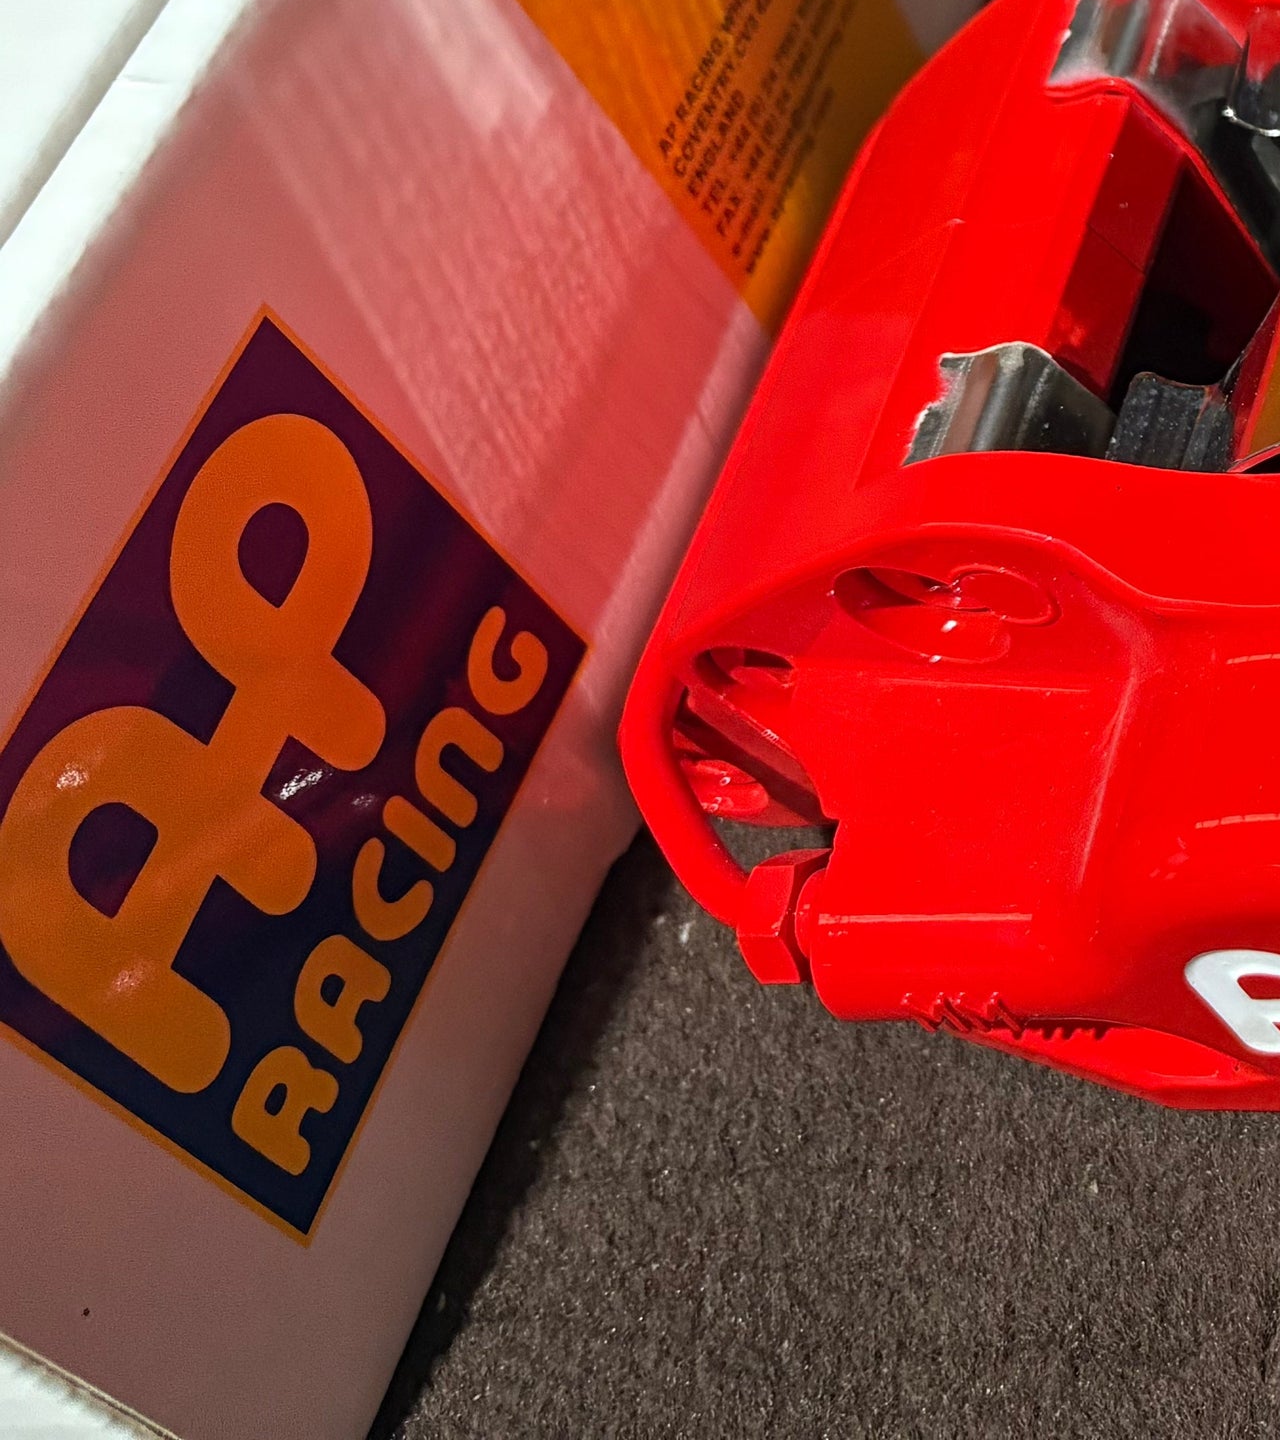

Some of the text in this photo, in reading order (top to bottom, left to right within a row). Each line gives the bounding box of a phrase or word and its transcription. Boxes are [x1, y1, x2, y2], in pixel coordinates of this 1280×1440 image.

[656, 120, 679, 160] AP
[685, 87, 747, 200] ENGLAND
[0, 413, 386, 1094] AP
[230, 606, 548, 1176] RACING
